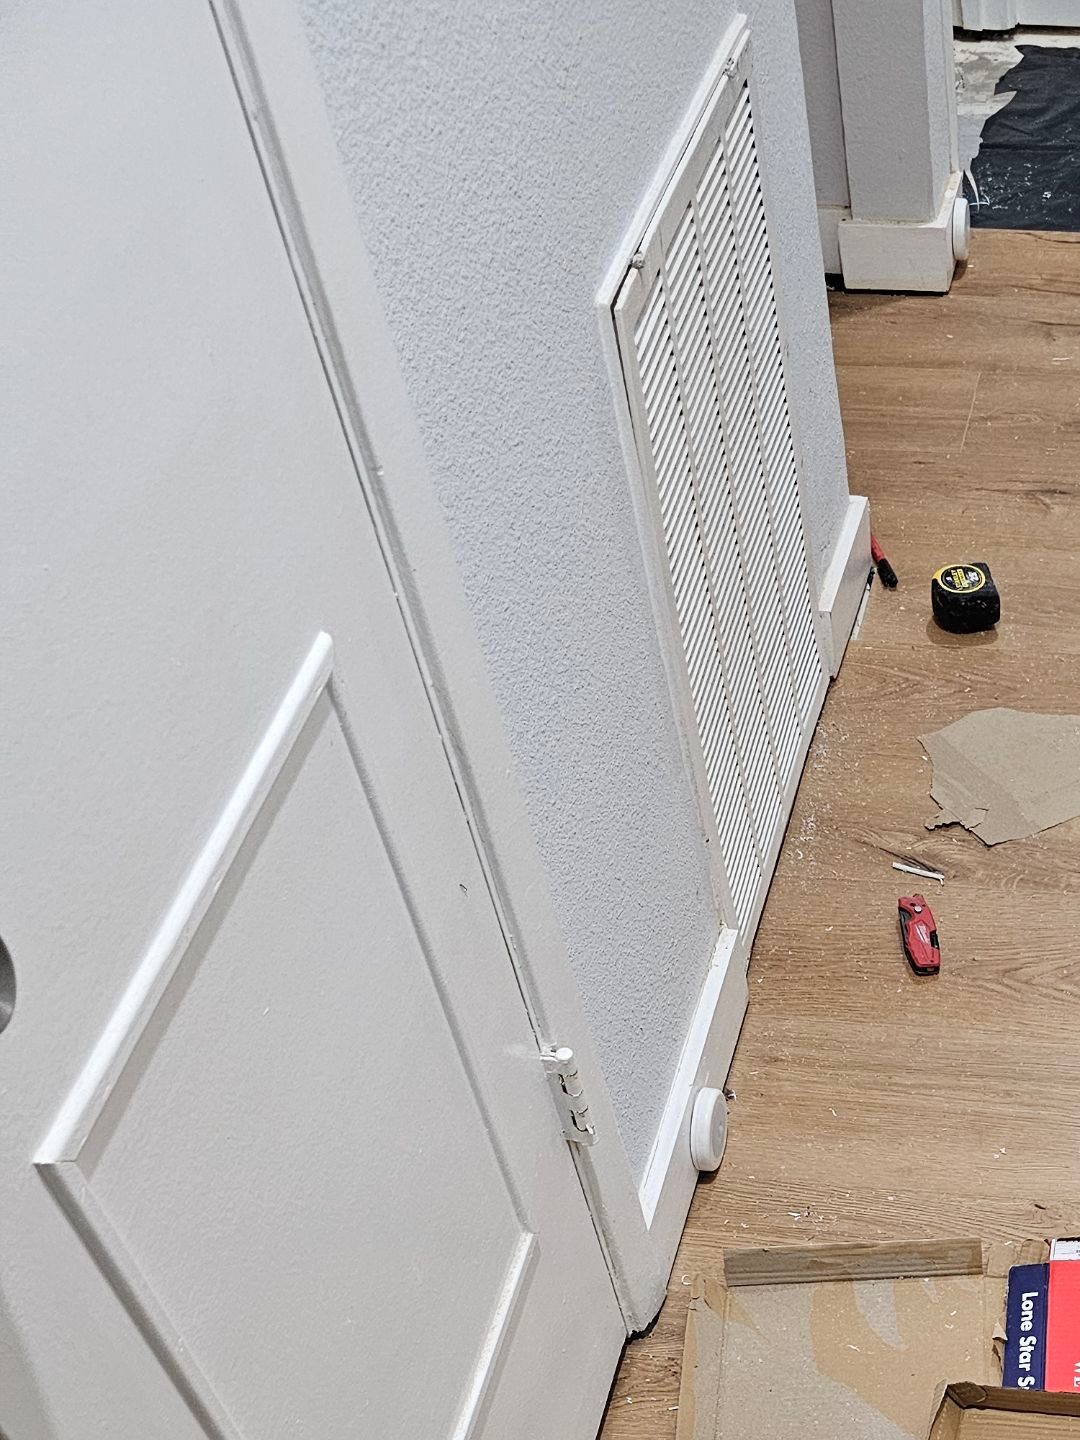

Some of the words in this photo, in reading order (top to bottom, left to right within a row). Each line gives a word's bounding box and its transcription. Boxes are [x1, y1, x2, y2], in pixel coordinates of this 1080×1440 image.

[1020, 1291, 1039, 1331] Lone
[1018, 1335, 1037, 1372] Star
[1017, 1376, 1036, 1390] S
